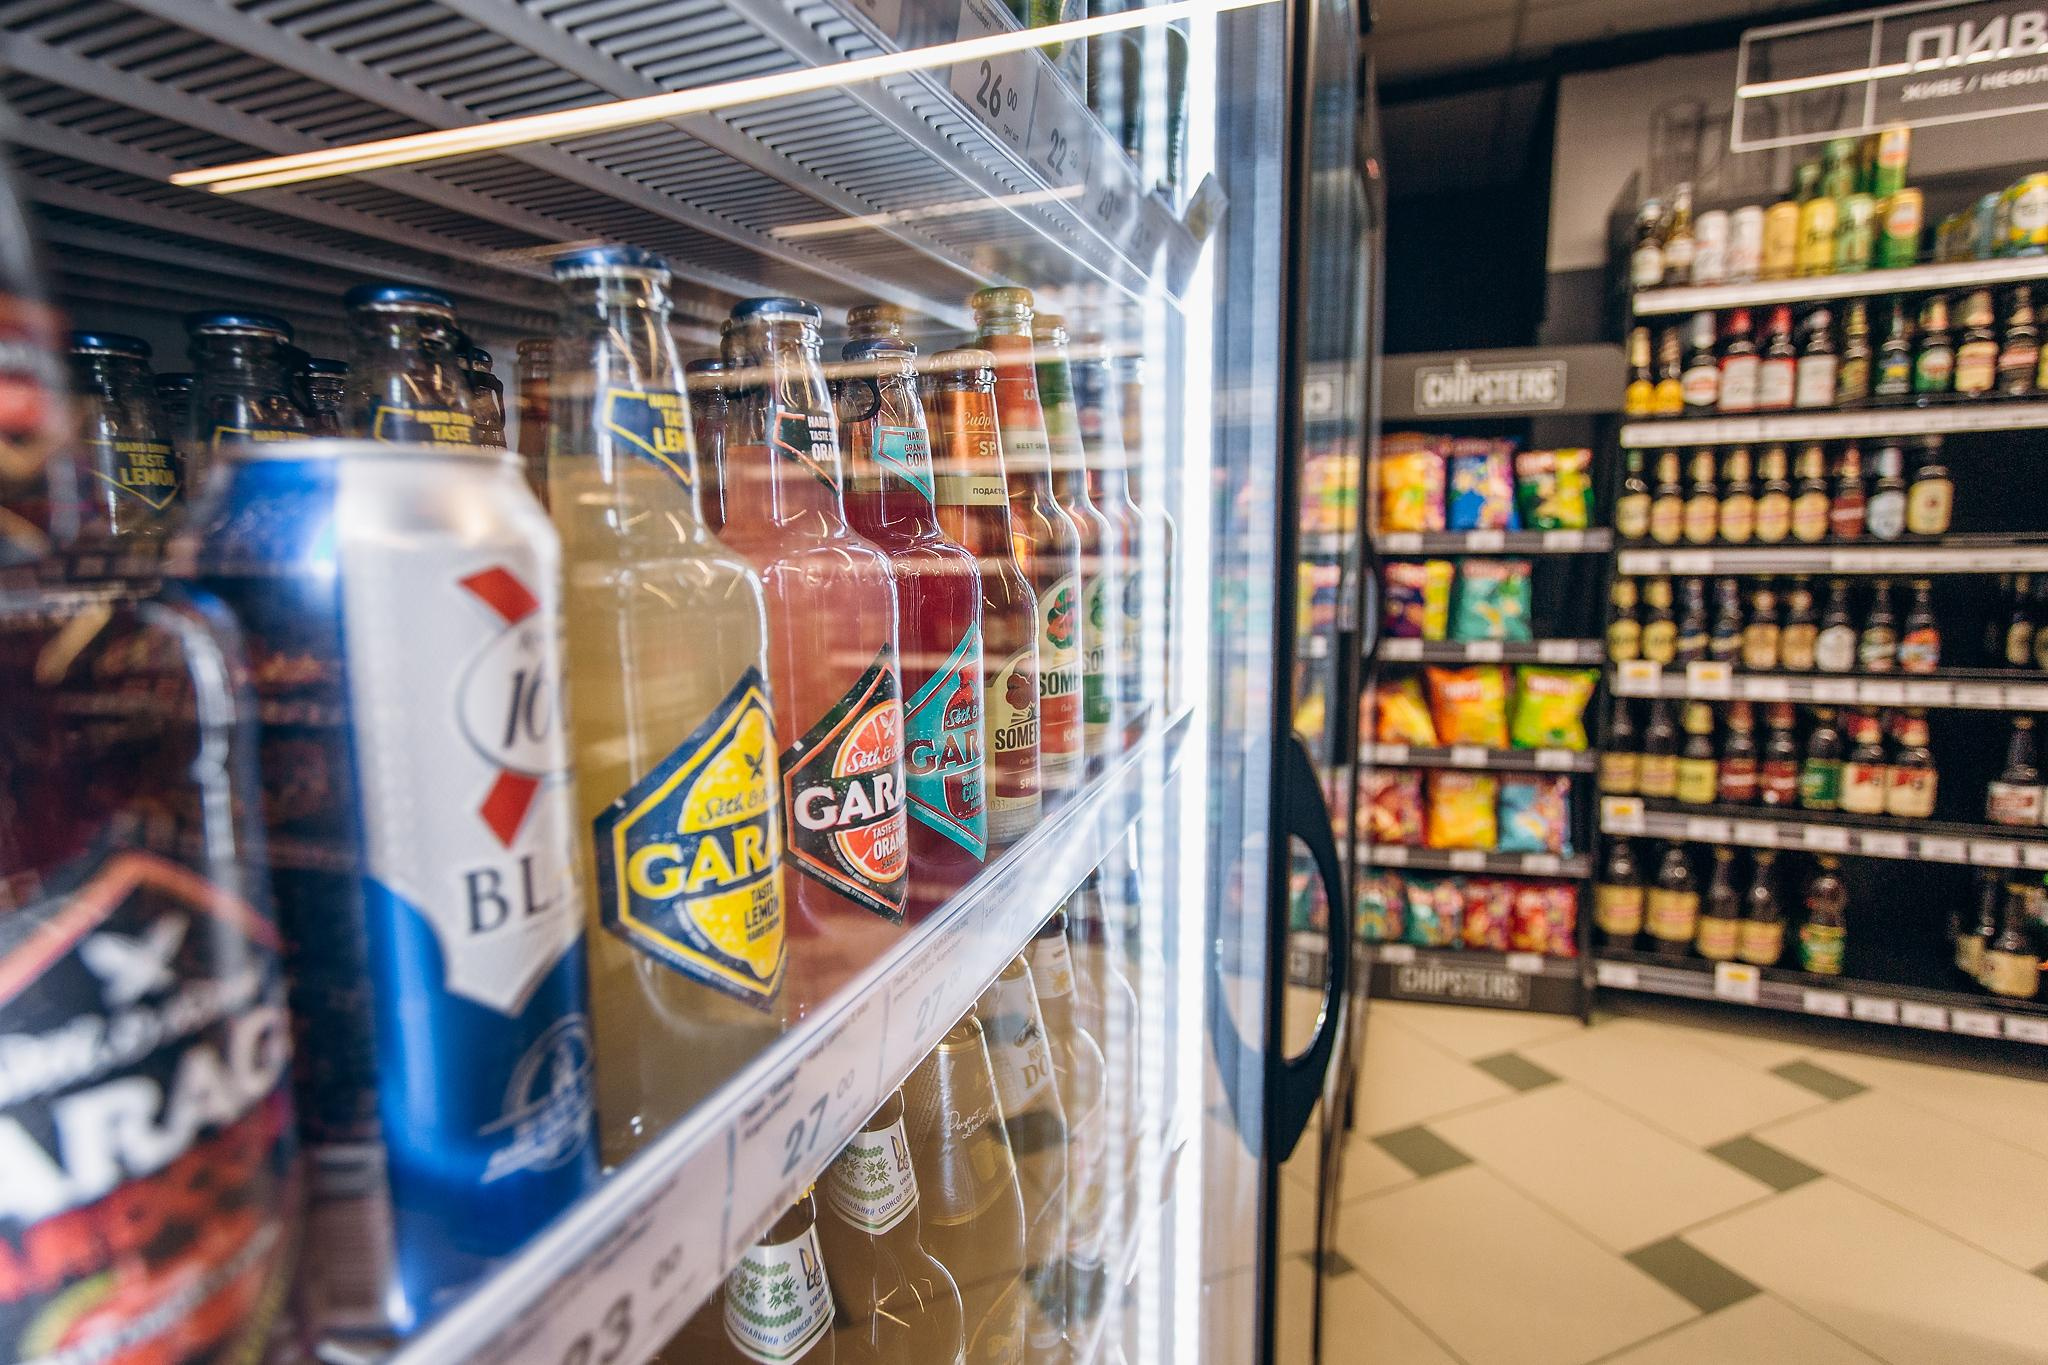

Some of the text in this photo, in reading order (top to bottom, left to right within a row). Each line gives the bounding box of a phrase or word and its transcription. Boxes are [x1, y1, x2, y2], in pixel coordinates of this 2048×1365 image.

[976, 60, 1003, 117] 26
[1007, 87, 1018, 112] 00
[964, 411, 991, 430] Сидр
[846, 745, 881, 773] Seth
[782, 1092, 829, 1177] 27
[878, 1192, 903, 1215] СПОНСОР
[783, 1315, 813, 1343] СПОНСОР
